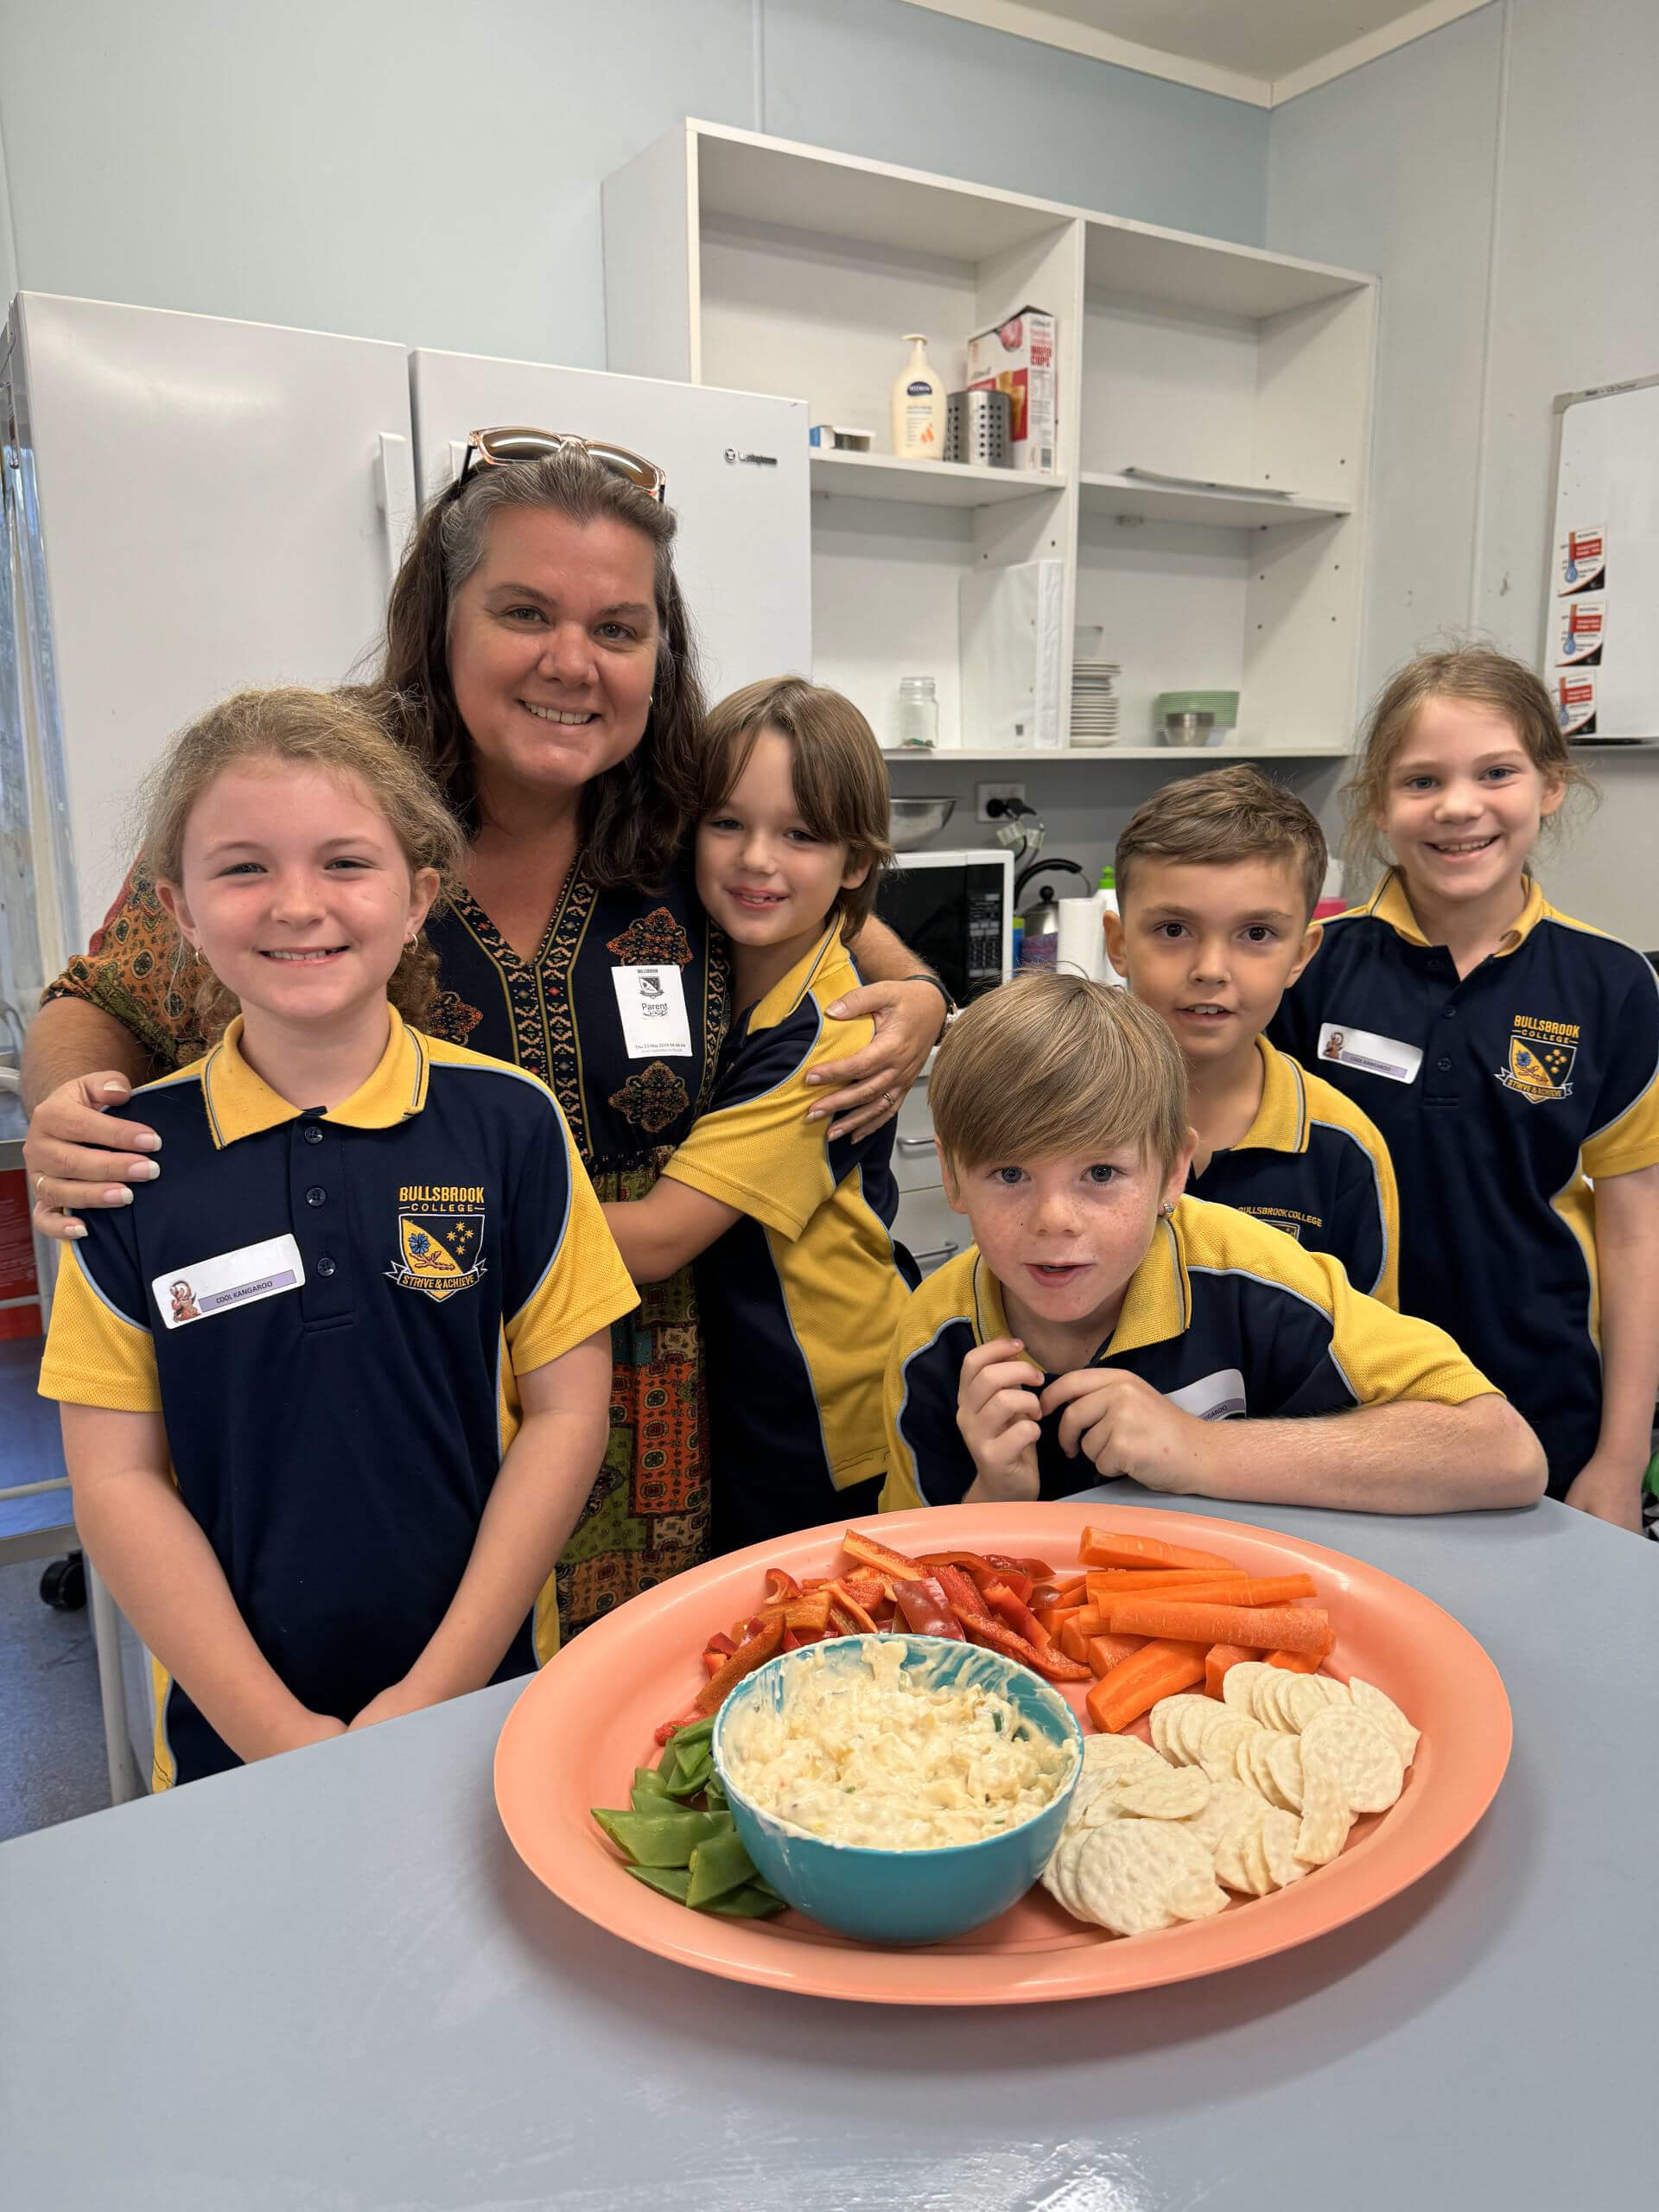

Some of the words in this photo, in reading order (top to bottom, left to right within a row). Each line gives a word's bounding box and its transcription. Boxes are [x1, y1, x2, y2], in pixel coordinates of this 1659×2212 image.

[641, 1002, 668, 1011] Parent
[1514, 1014, 1581, 1039] BULLSBROOK
[1521, 1030, 1571, 1044] COLLEGE
[1507, 1079, 1530, 1093] STRIVE
[398, 1185, 485, 1204] BULLSBROOK
[410, 1203, 474, 1213] COLLEGE
[1287, 1210, 1323, 1228] COLLEGE
[402, 1274, 435, 1289] STRIVE
[442, 1274, 475, 1289] ACHIEVE
[216, 1289, 235, 1305] COOL
[234, 1281, 274, 1300] KANGAROO
[1203, 1405, 1227, 1421] NGAROO
